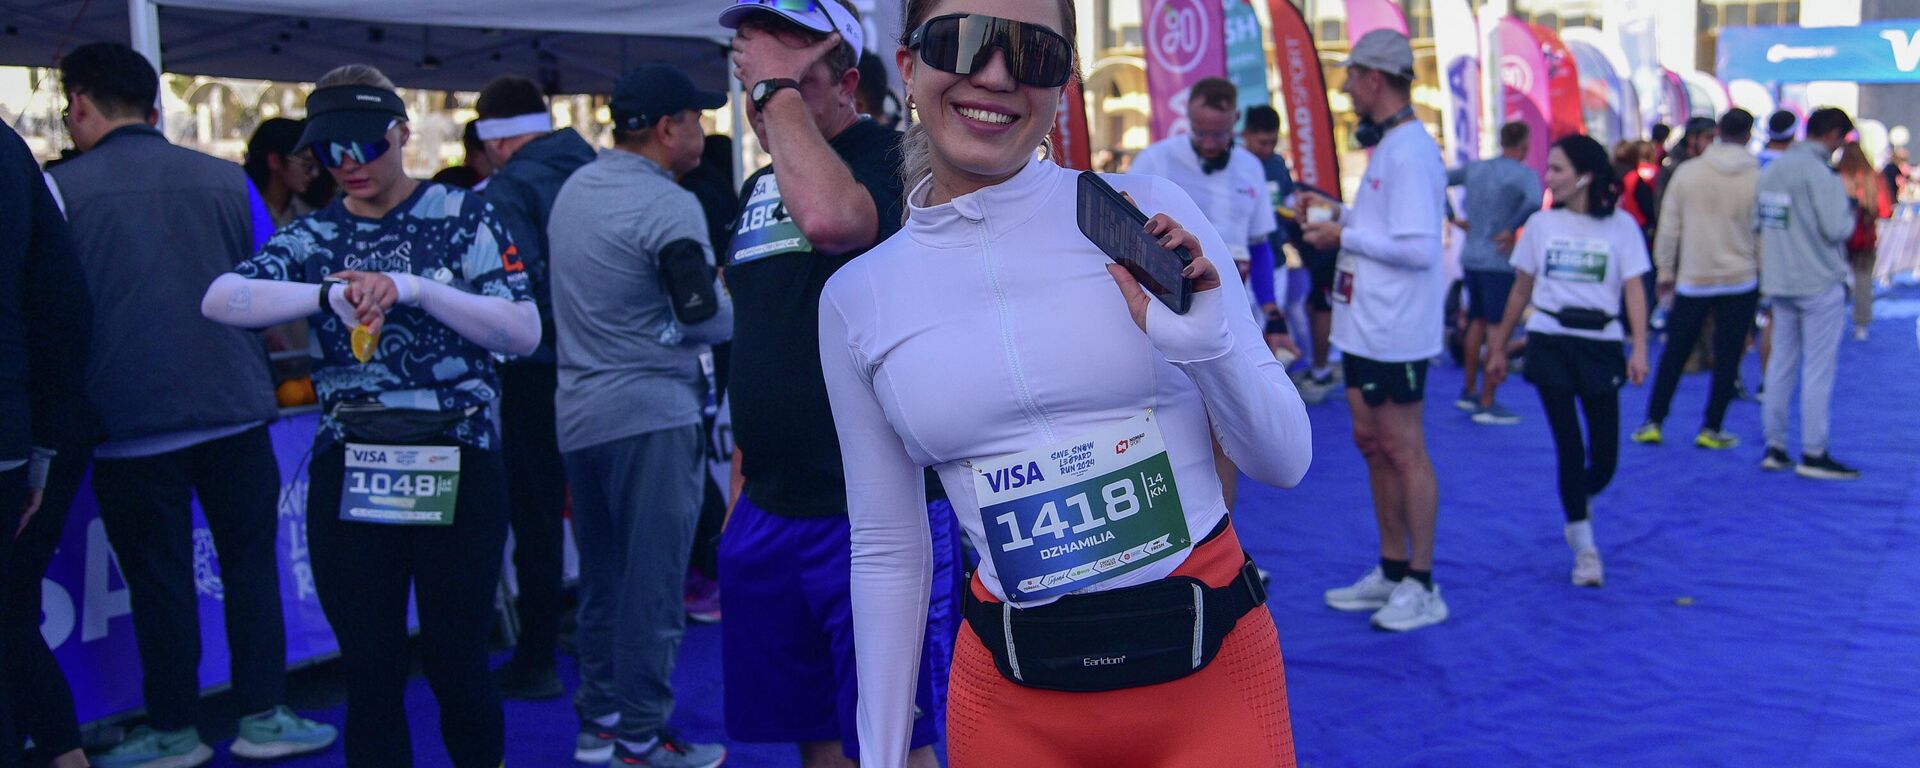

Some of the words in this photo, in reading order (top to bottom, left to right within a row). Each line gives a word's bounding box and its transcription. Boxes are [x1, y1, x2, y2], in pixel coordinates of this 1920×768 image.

[353, 450, 387, 463] VISA
[1050, 449, 1069, 461] SAVE
[1060, 464, 1076, 475] RUN
[1076, 459, 1095, 470] 2024
[349, 472, 436, 496] 1048
[982, 461, 1045, 493] VISA
[1147, 472, 1164, 487] 14
[1150, 484, 1167, 498] KM
[996, 478, 1140, 552] 1418
[1039, 530, 1116, 560] DZHAMILIA
